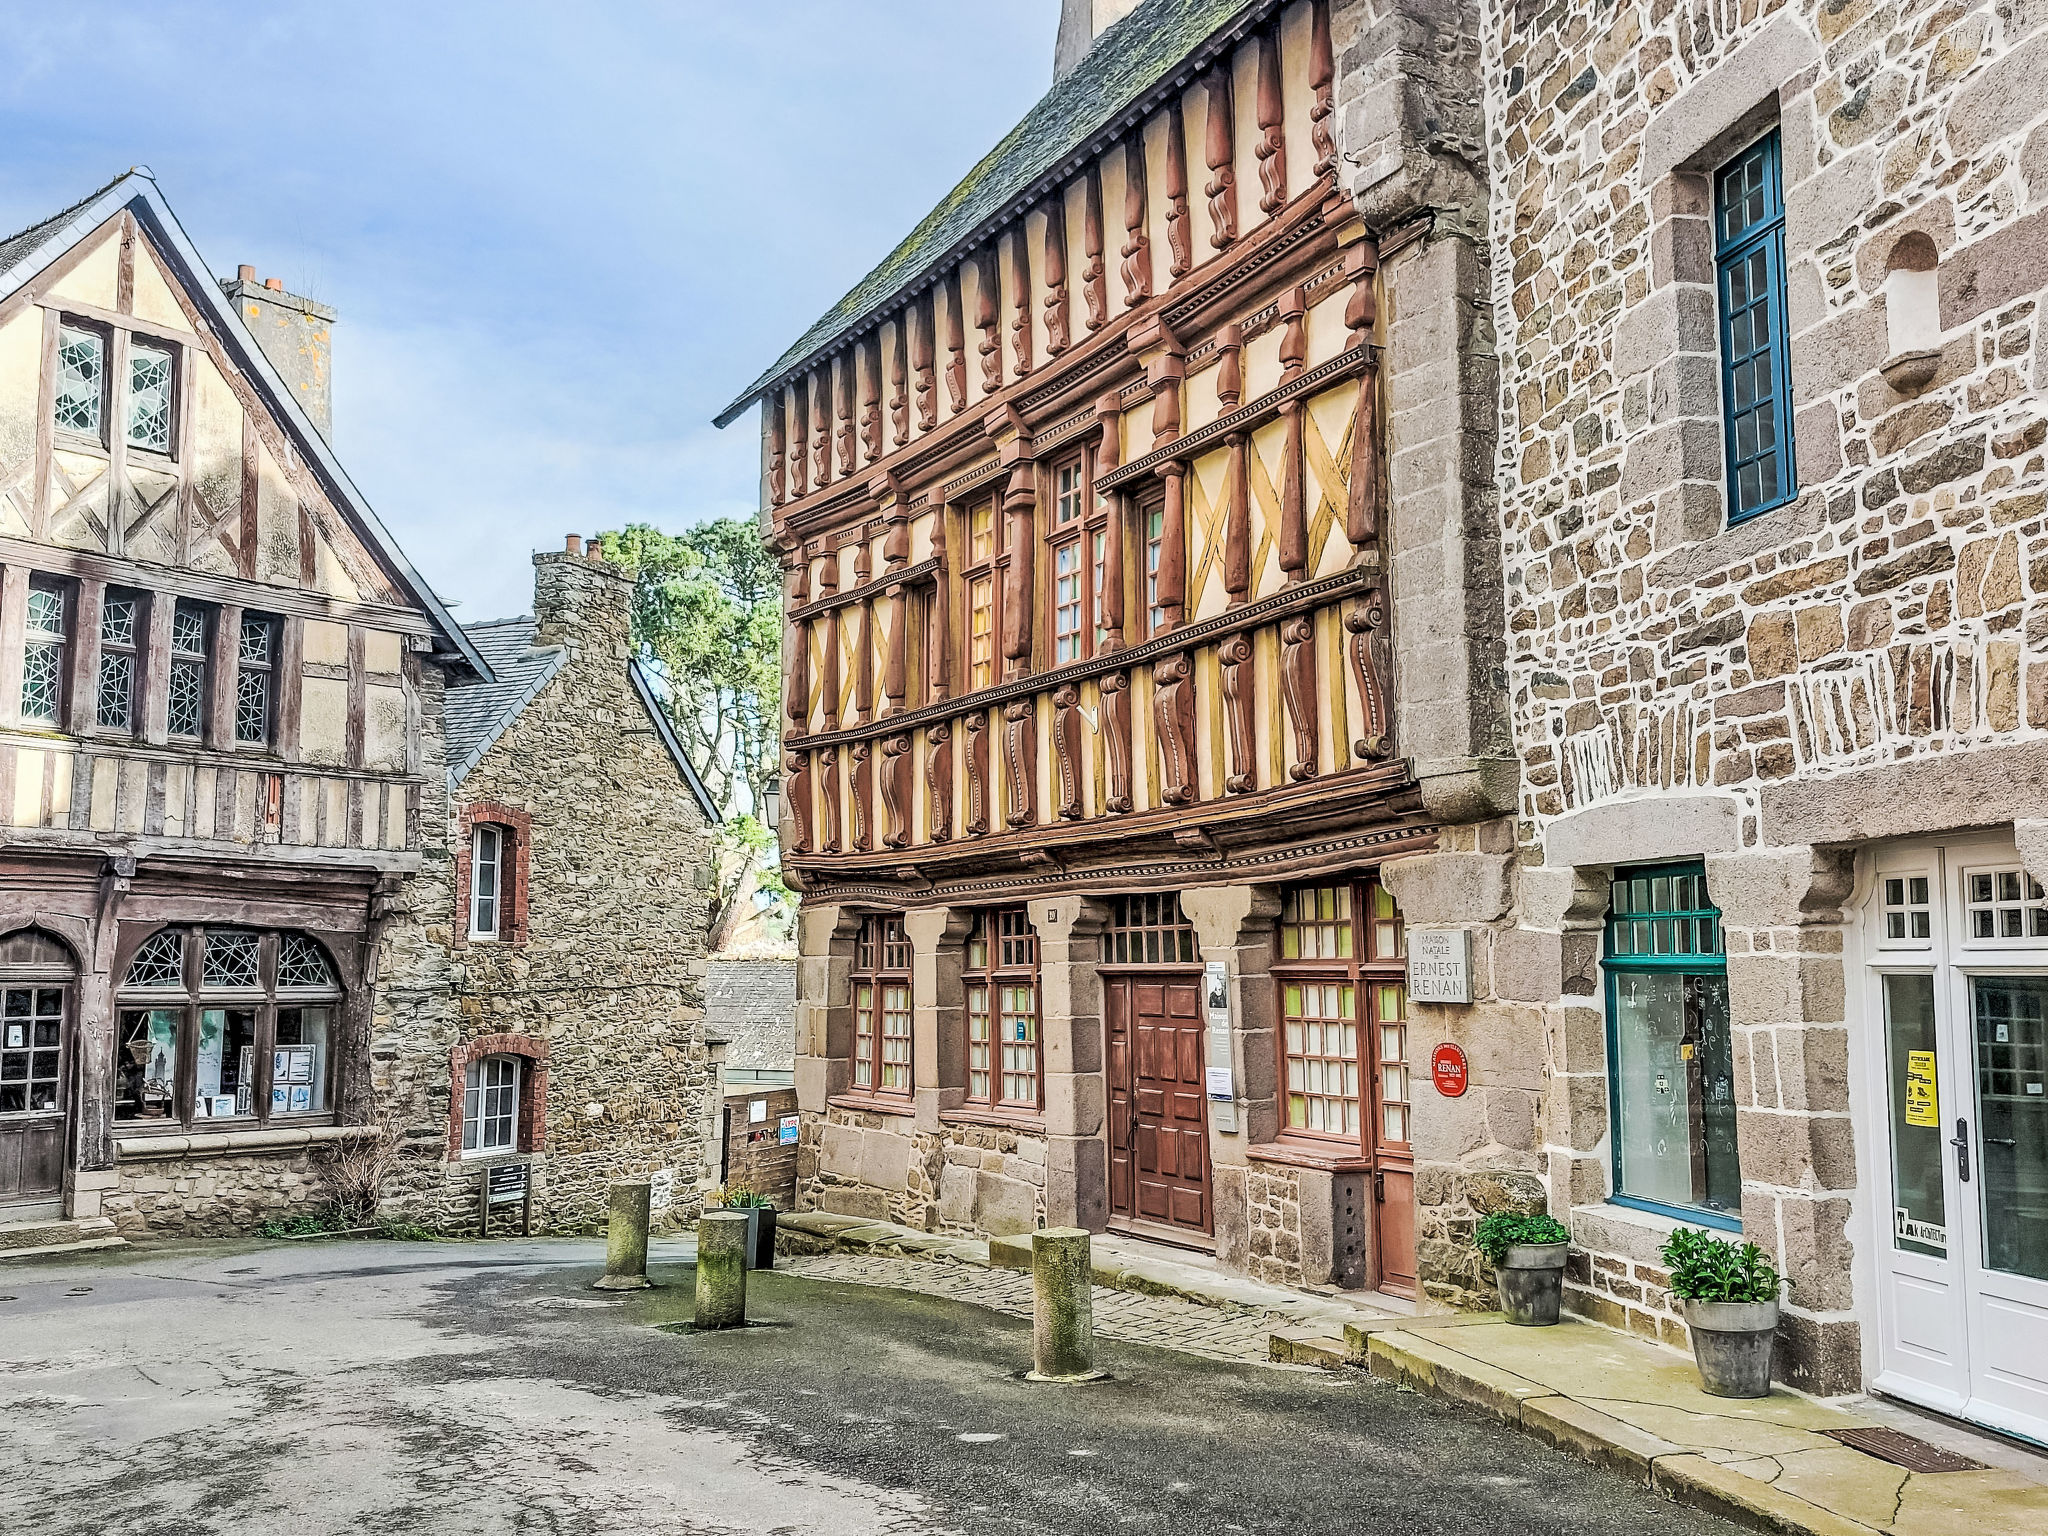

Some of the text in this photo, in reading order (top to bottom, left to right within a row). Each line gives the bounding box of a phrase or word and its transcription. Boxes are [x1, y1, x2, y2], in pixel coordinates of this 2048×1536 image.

[1422, 945, 1450, 955] NATALE
[1413, 962, 1461, 976] ERNEST
[1413, 979, 1462, 996] RENAN
[1437, 1063, 1461, 1073] RENAN
